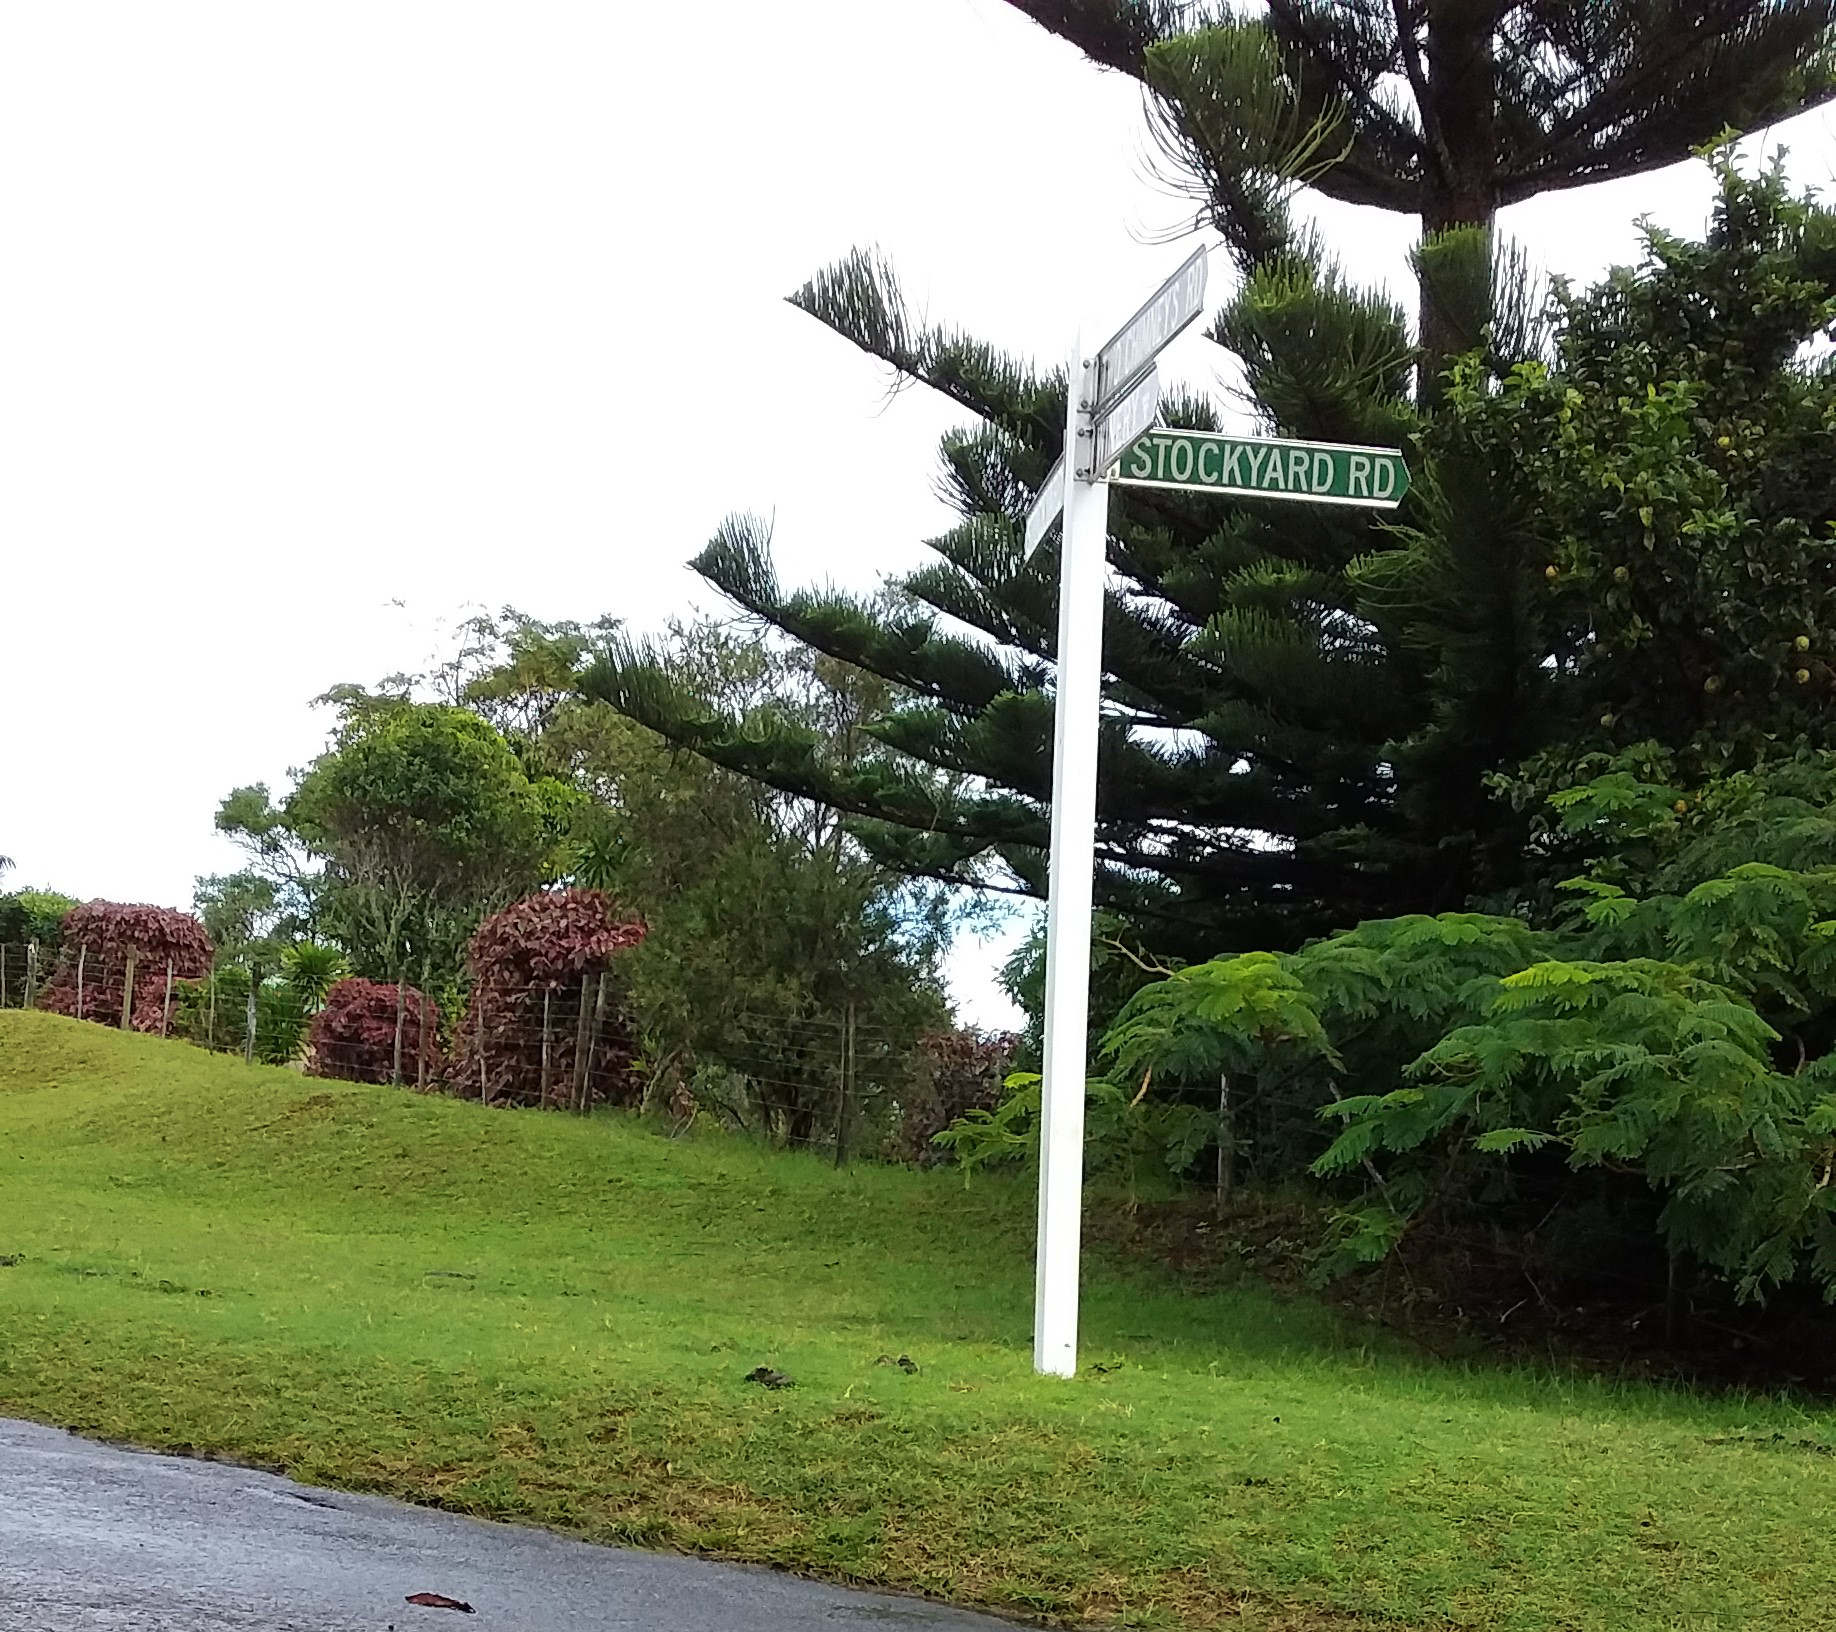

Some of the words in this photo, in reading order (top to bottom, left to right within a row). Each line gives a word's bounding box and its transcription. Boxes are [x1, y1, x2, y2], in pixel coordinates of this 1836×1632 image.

[1185, 256, 1203, 314] RD
[1130, 436, 1334, 494] STOCKYARD
[1348, 455, 1395, 499] RD
